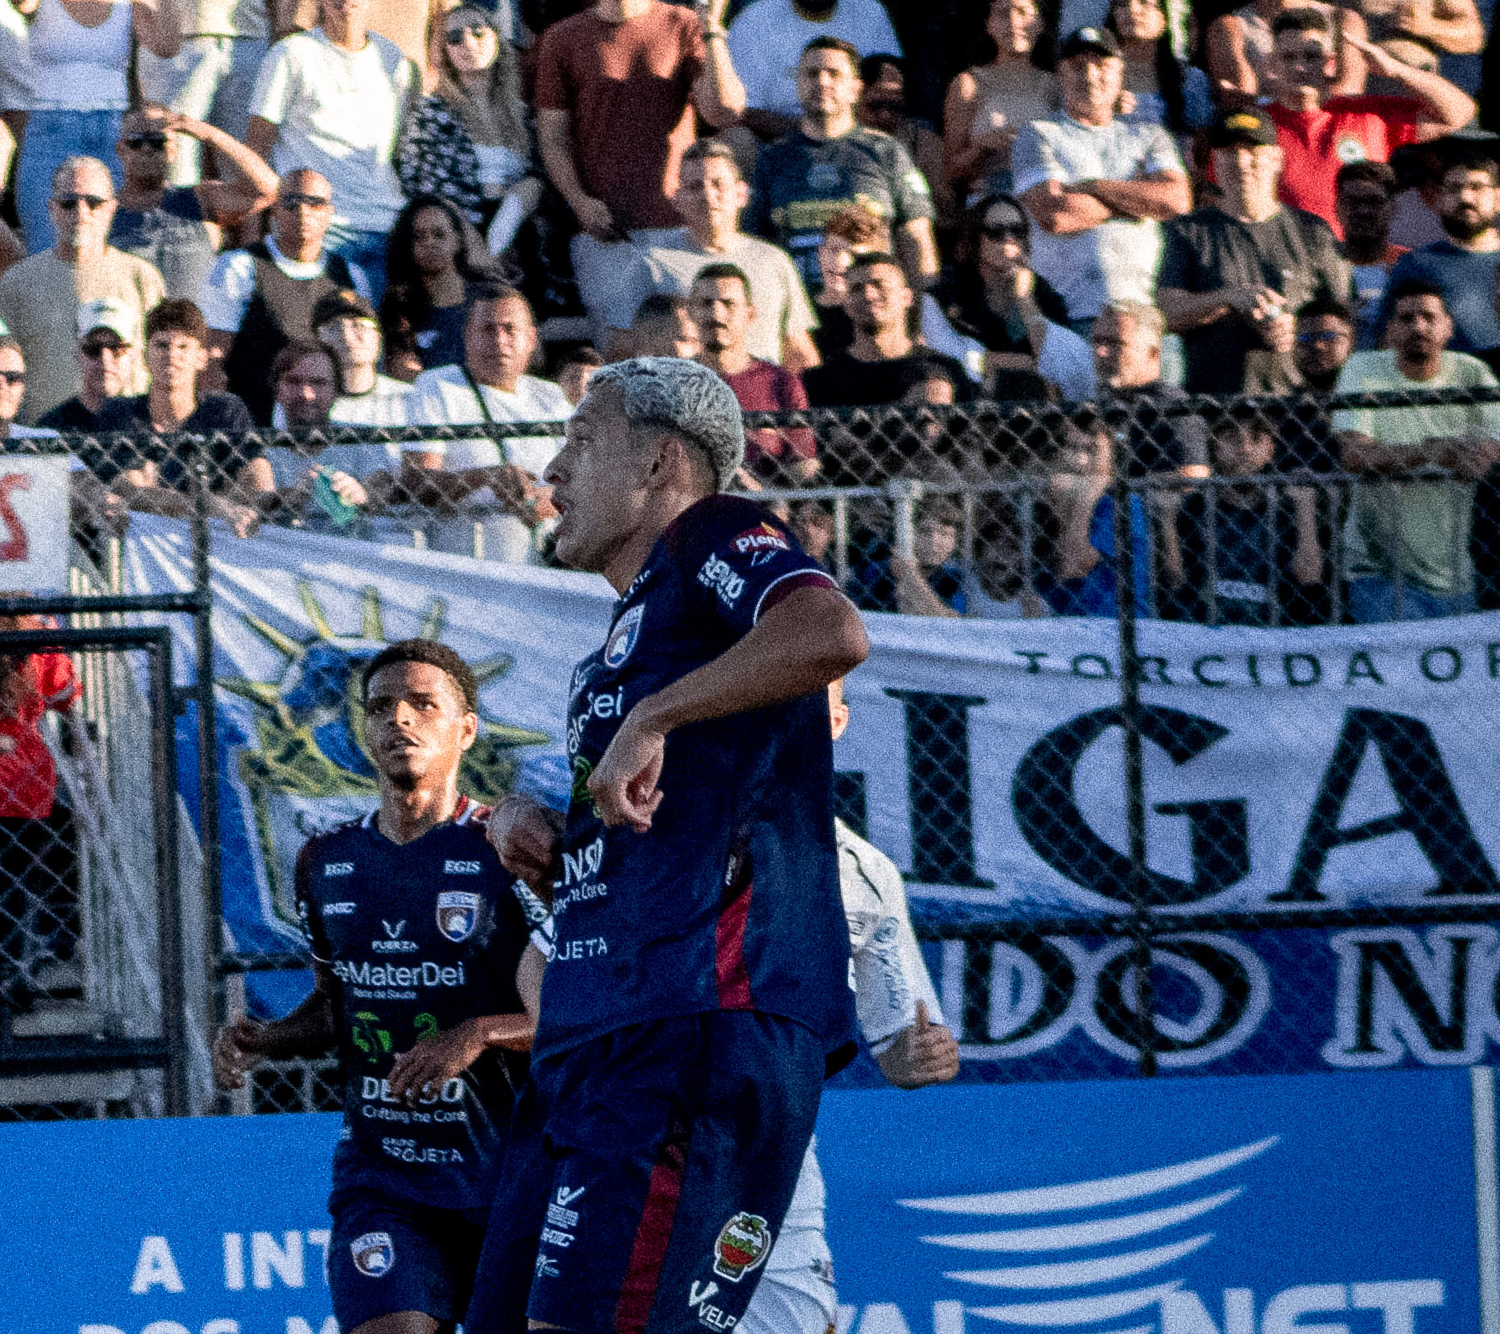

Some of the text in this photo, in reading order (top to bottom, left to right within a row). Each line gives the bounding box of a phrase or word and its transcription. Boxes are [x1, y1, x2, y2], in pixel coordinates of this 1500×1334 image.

[1015, 649, 1385, 688] TORCIDA
[443, 858, 481, 876] EGIS
[349, 960, 465, 988] MaterDei
[131, 1236, 184, 1295] A
